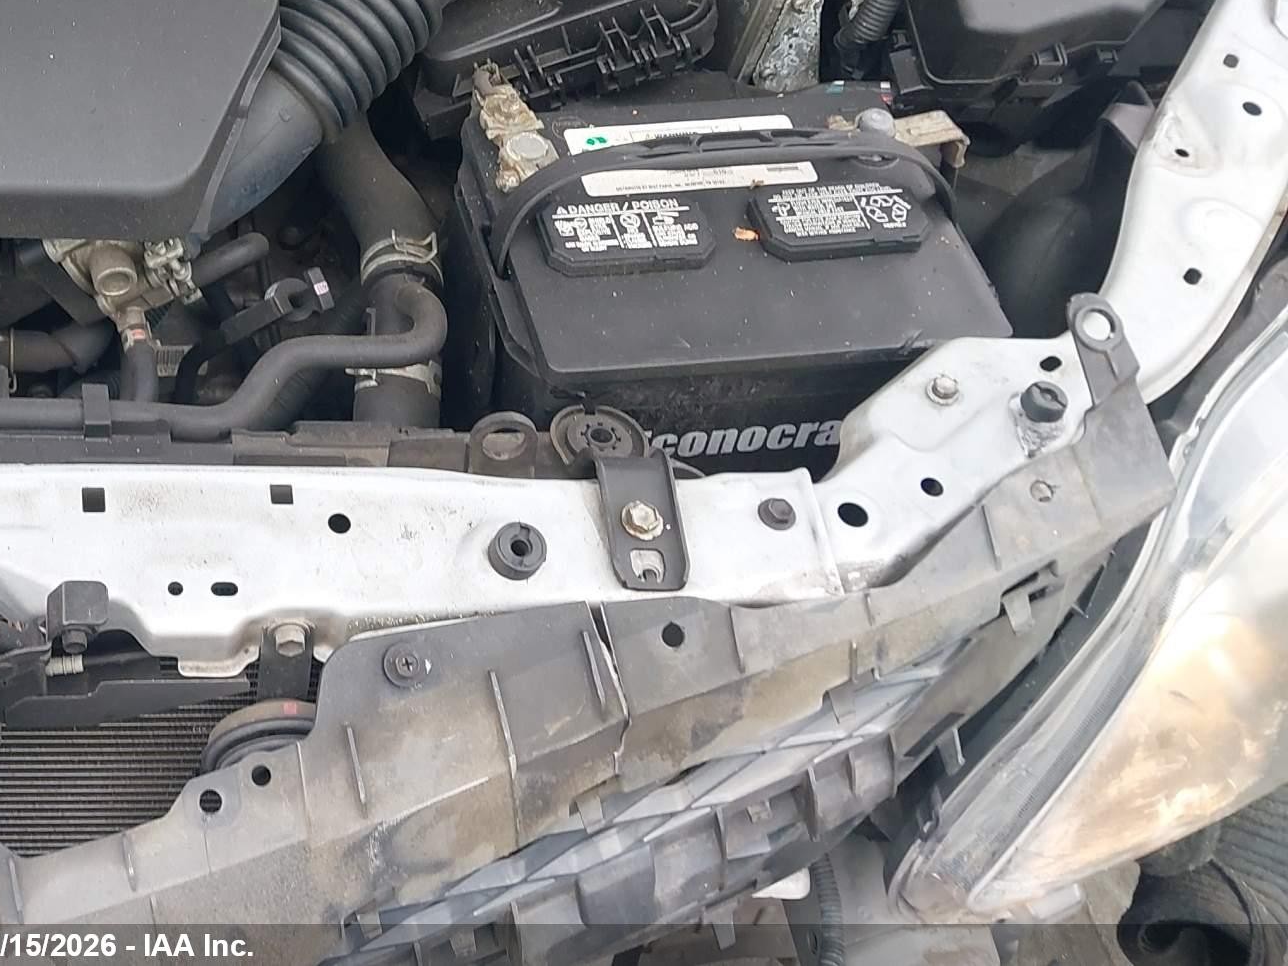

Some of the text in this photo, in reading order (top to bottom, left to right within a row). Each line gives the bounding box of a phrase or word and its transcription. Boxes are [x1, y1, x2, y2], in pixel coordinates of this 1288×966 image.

[567, 201, 620, 216] DANGER
[631, 197, 680, 211] POISON
[646, 419, 841, 458] conocra
